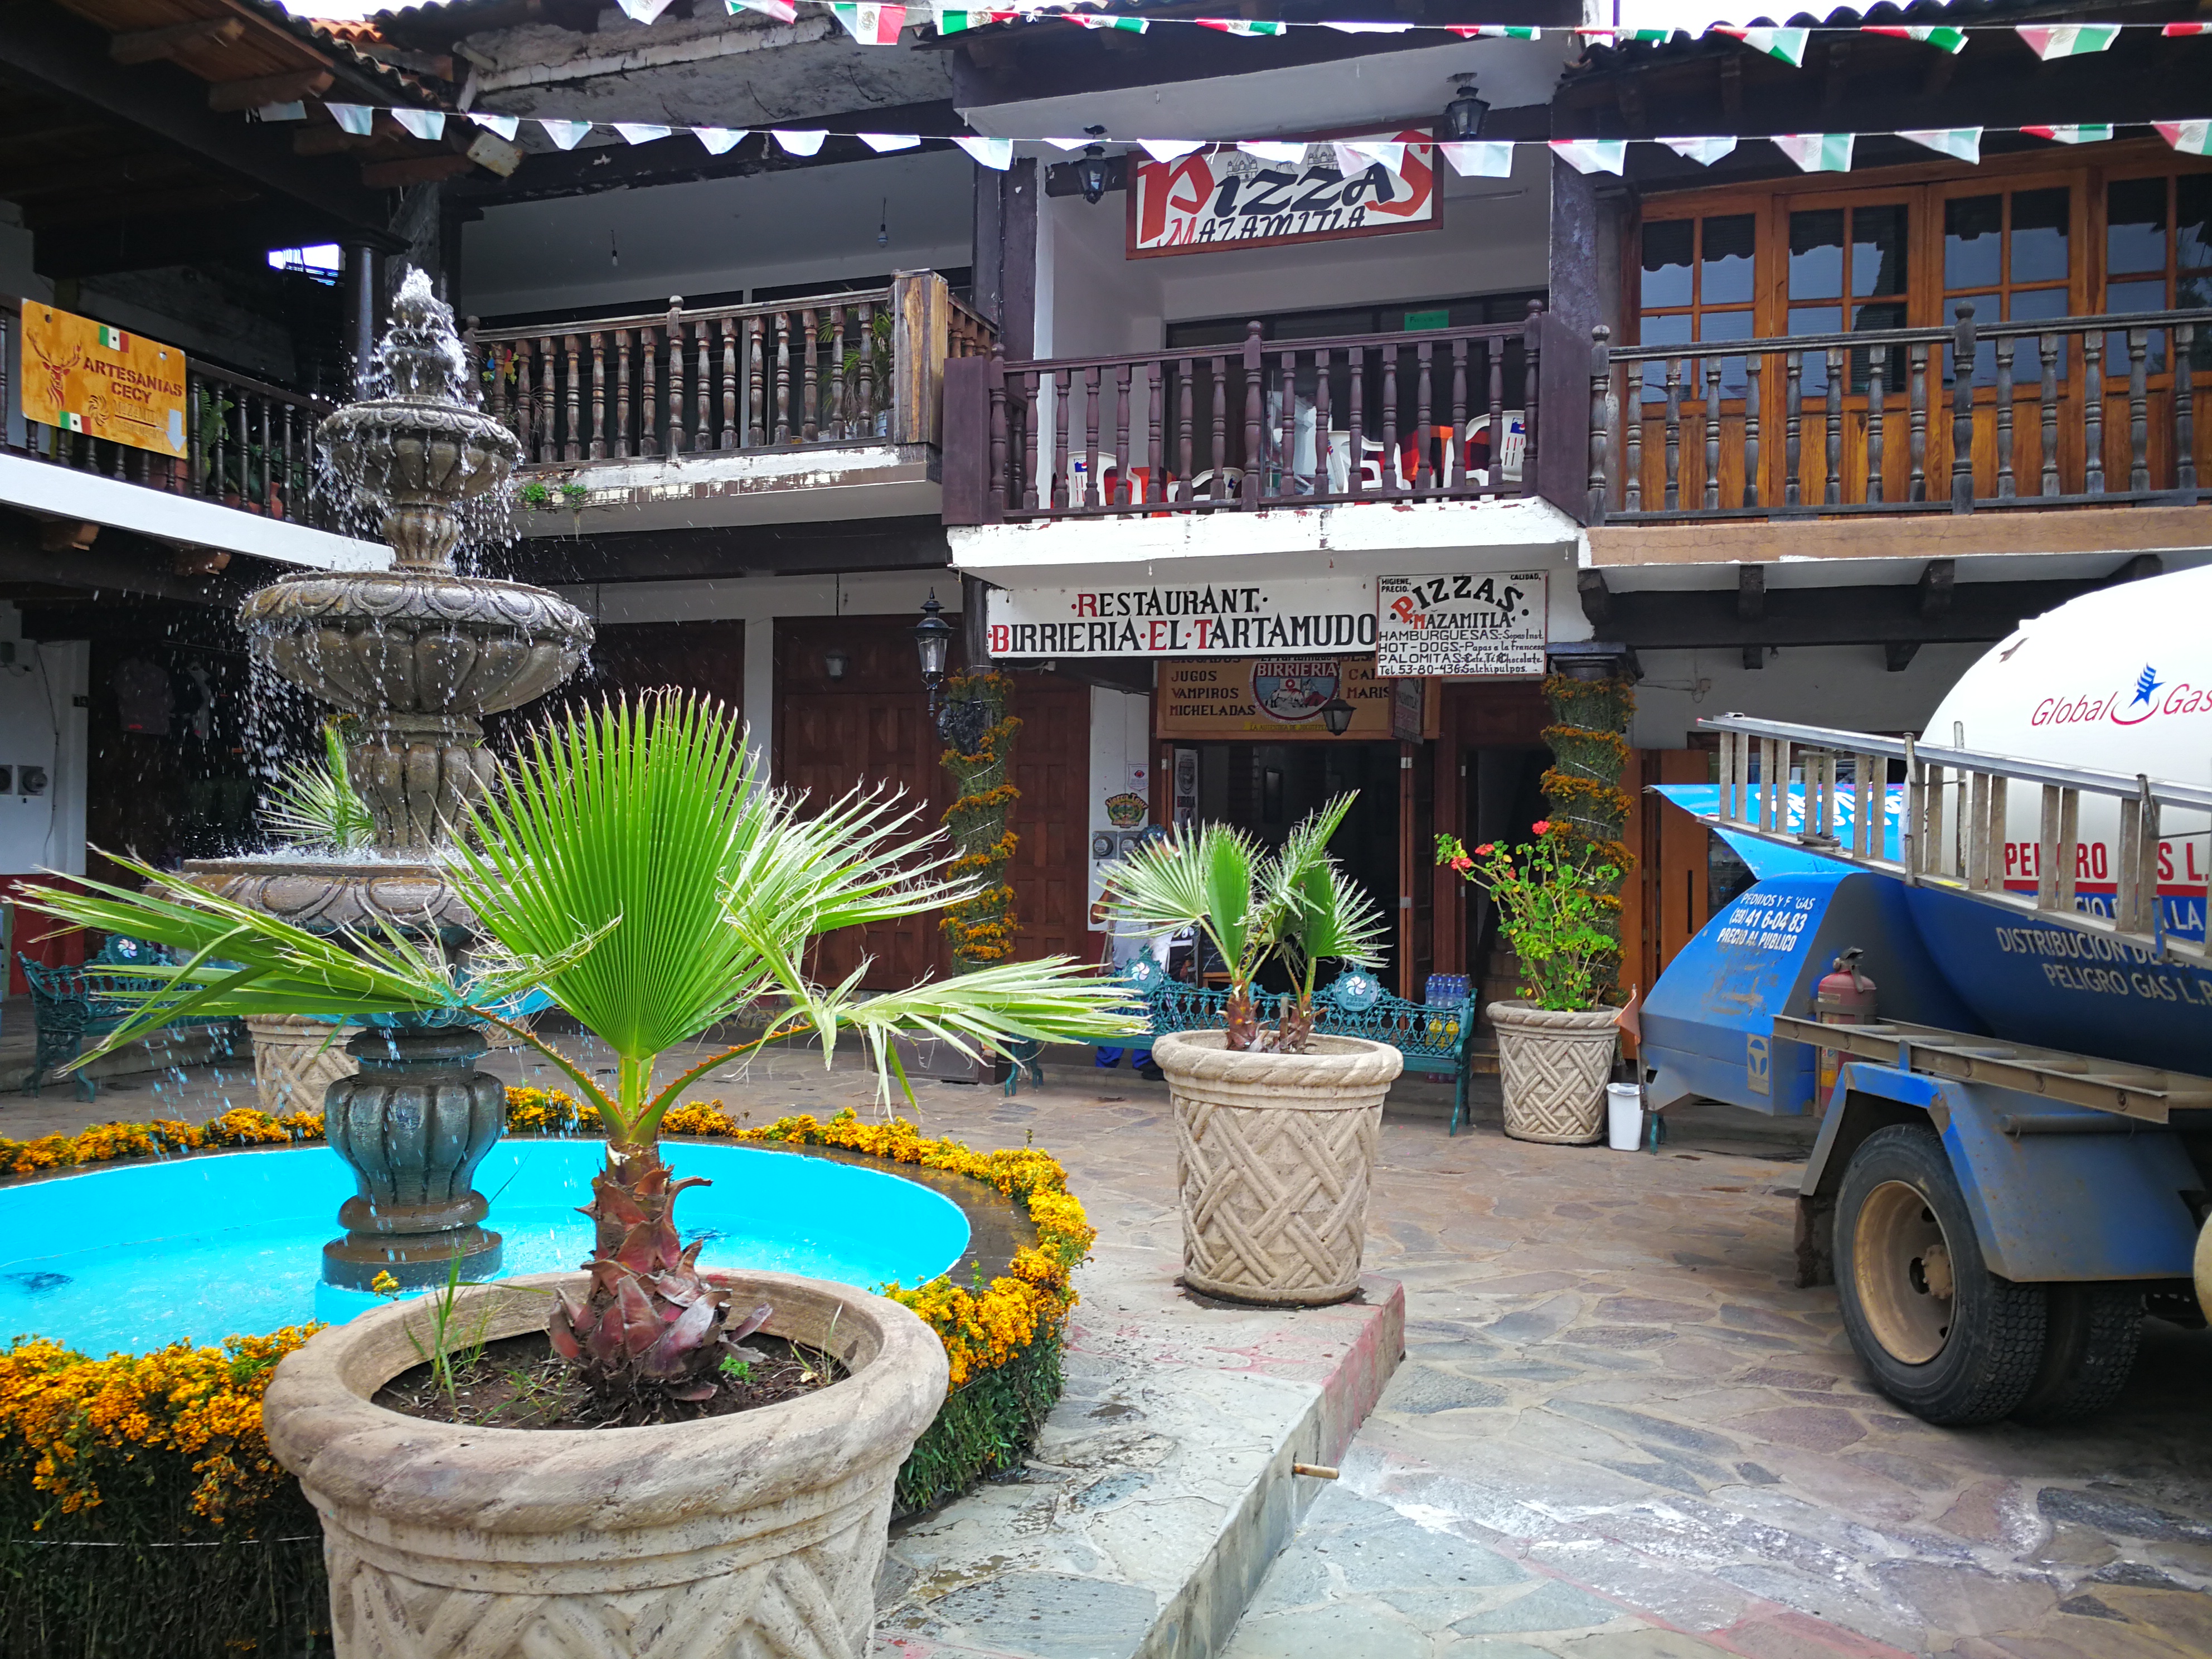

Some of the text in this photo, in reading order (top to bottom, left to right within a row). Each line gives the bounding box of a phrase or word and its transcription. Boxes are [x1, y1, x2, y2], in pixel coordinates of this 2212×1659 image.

[1137, 130, 1433, 244] PIZZAS
[1157, 205, 1366, 246] MAZAMITLA
[83, 357, 182, 397] ARTESANIAS
[111, 381, 152, 404] CECY
[1077, 584, 1259, 617] RESTAURANT
[1391, 576, 1524, 624] PIZZAS
[991, 612, 1377, 653] BIRRIERIA EL TARTAMUDO
[1413, 612, 1512, 629] MAZAMITLA
[1465, 642, 1491, 656] Papas
[1501, 641, 1510, 651] la
[1511, 641, 1545, 651] Francesa
[1171, 671, 1217, 682] JUGOS
[1257, 663, 1337, 676] BIRRIERIA
[1171, 688, 1239, 699] VAMPIROS
[1347, 686, 1389, 698] MARIS
[1170, 705, 1256, 716] MICHELADAS
[2031, 683, 2212, 726] Global Gas
[1716, 928, 1798, 952] PRECIO AL PUBLICO
[2043, 963, 2128, 996] PELIGRO
[2131, 972, 2177, 1001] GAS
